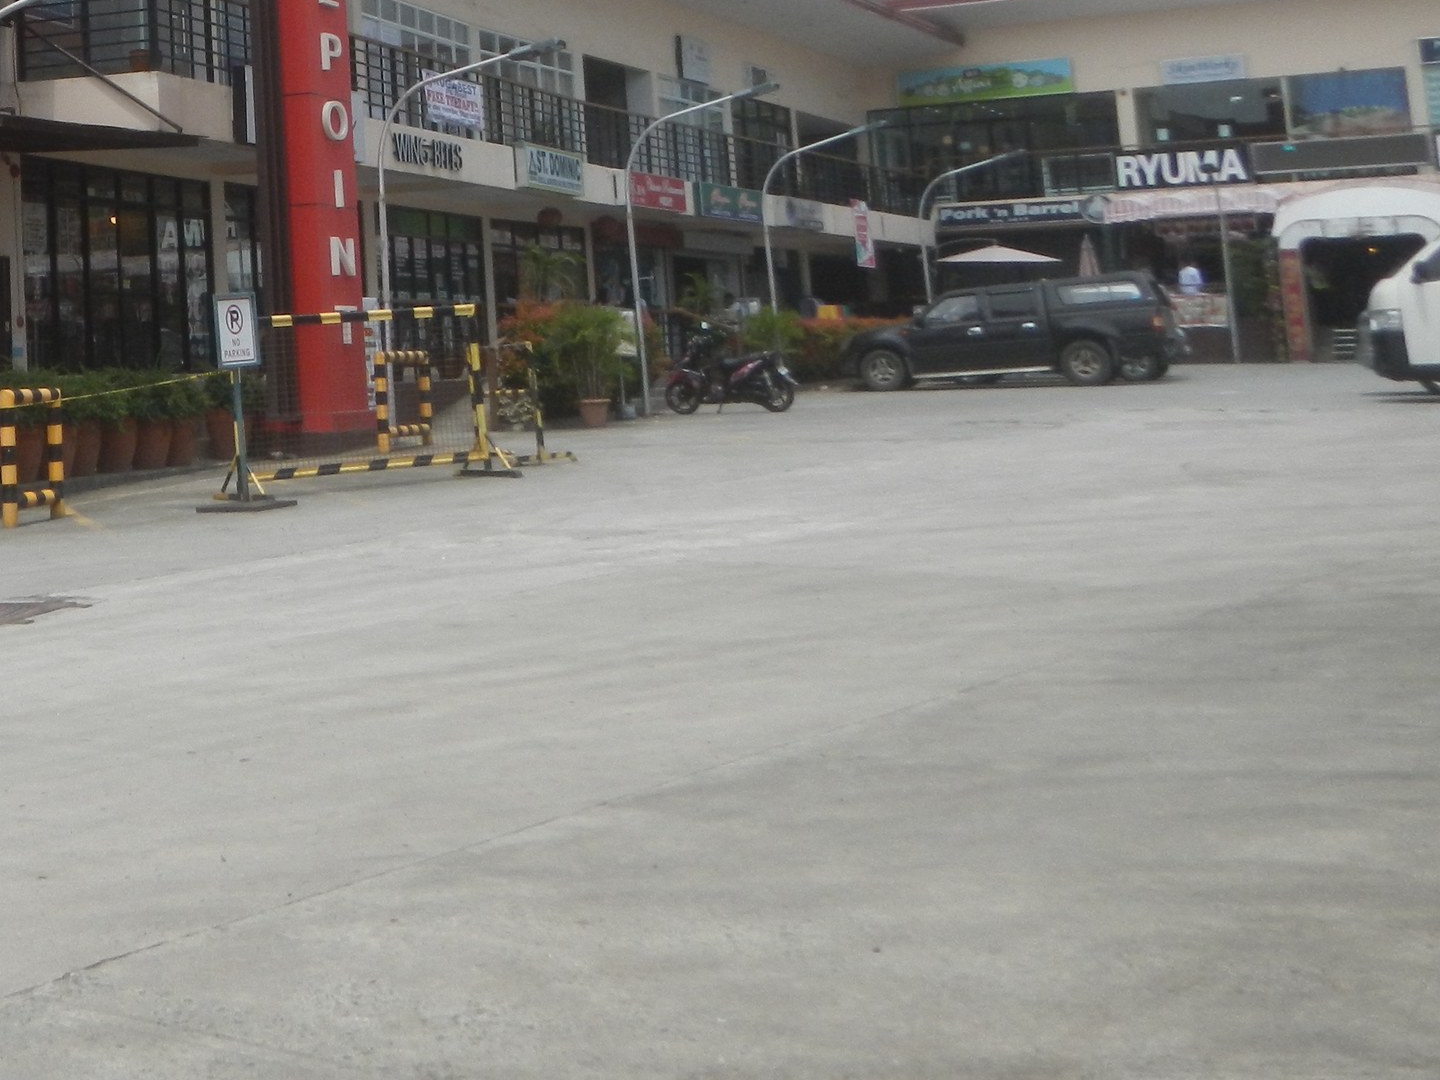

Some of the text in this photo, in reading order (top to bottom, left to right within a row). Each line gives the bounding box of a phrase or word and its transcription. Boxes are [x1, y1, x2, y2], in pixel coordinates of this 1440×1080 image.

[392, 132, 429, 166] WING
[940, 206, 989, 221] Pork
[1013, 200, 1079, 216] Barrel
[231, 338, 242, 347] NO
[223, 348, 251, 359] PARKING
